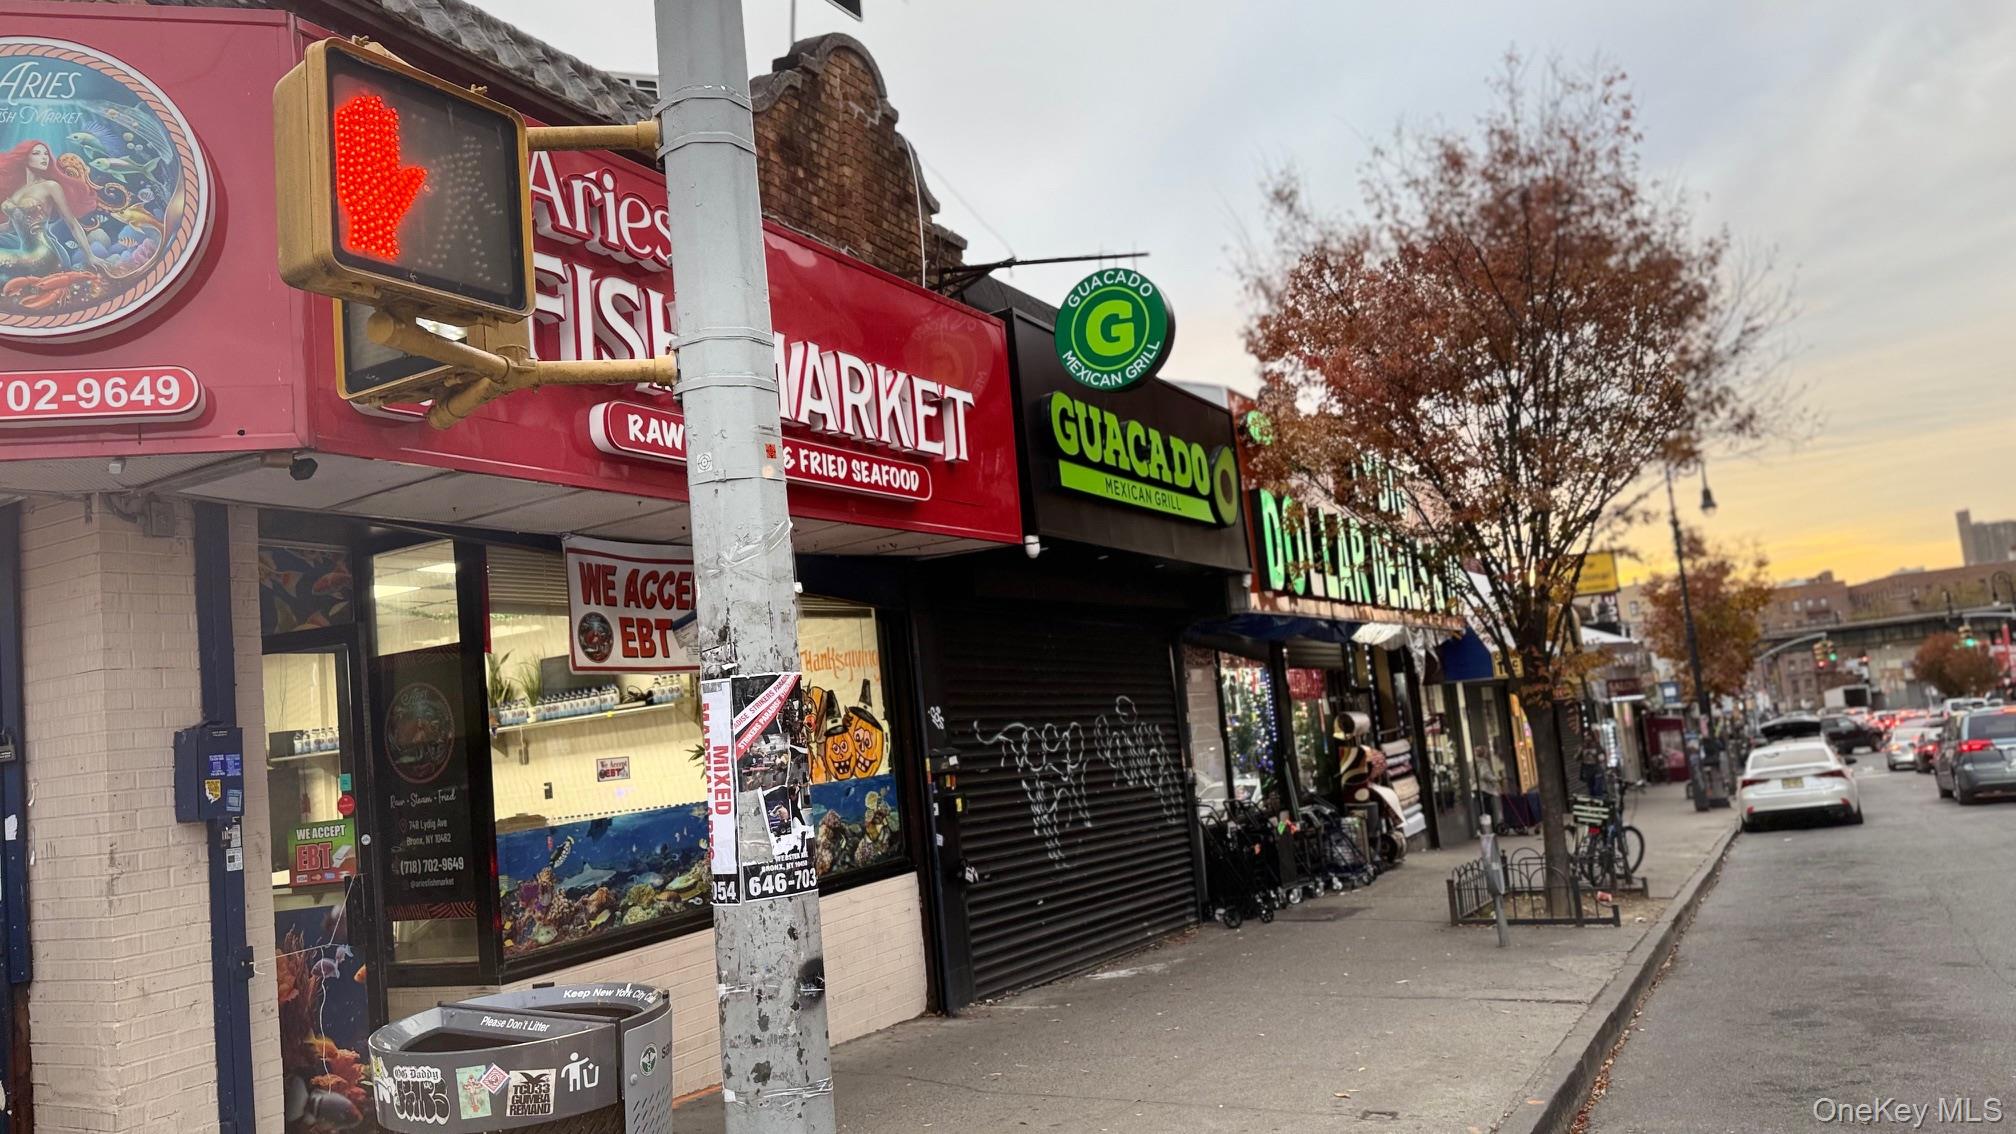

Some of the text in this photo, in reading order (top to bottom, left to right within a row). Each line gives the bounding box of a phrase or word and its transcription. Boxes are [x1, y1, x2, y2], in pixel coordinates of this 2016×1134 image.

[0, 61, 82, 106] ARIES
[0, 105, 82, 126] SH MARKET
[1067, 269, 1153, 308] GUACADO
[1085, 299, 1135, 357] G
[1062, 340, 1161, 387] MEXICAN GRILL
[0, 374, 181, 412] 02-9649
[1051, 390, 1211, 496] GUACADO
[783, 446, 796, 469] &
[800, 447, 848, 480] FRIED
[851, 458, 919, 492] SEAFOOD
[1104, 477, 1182, 512] MEXICAN GRILL
[1260, 488, 1372, 605] DOLLAR
[579, 561, 697, 611] WE ACCE
[618, 617, 674, 658] EBT
[749, 690, 775, 714] STRIKERS
[438, 788, 456, 803] Fried
[713, 745, 731, 815] MIXED
[296, 825, 346, 840] WE ACCEPT
[437, 818, 448, 827] Ave
[296, 842, 332, 871] EBT
[400, 857, 464, 875] (718) 702-9649
[563, 989, 590, 999] Keep
[592, 988, 614, 997] New
[480, 1015, 550, 1032] Please Don't Litter
[410, 1069, 439, 1080] Daddy
